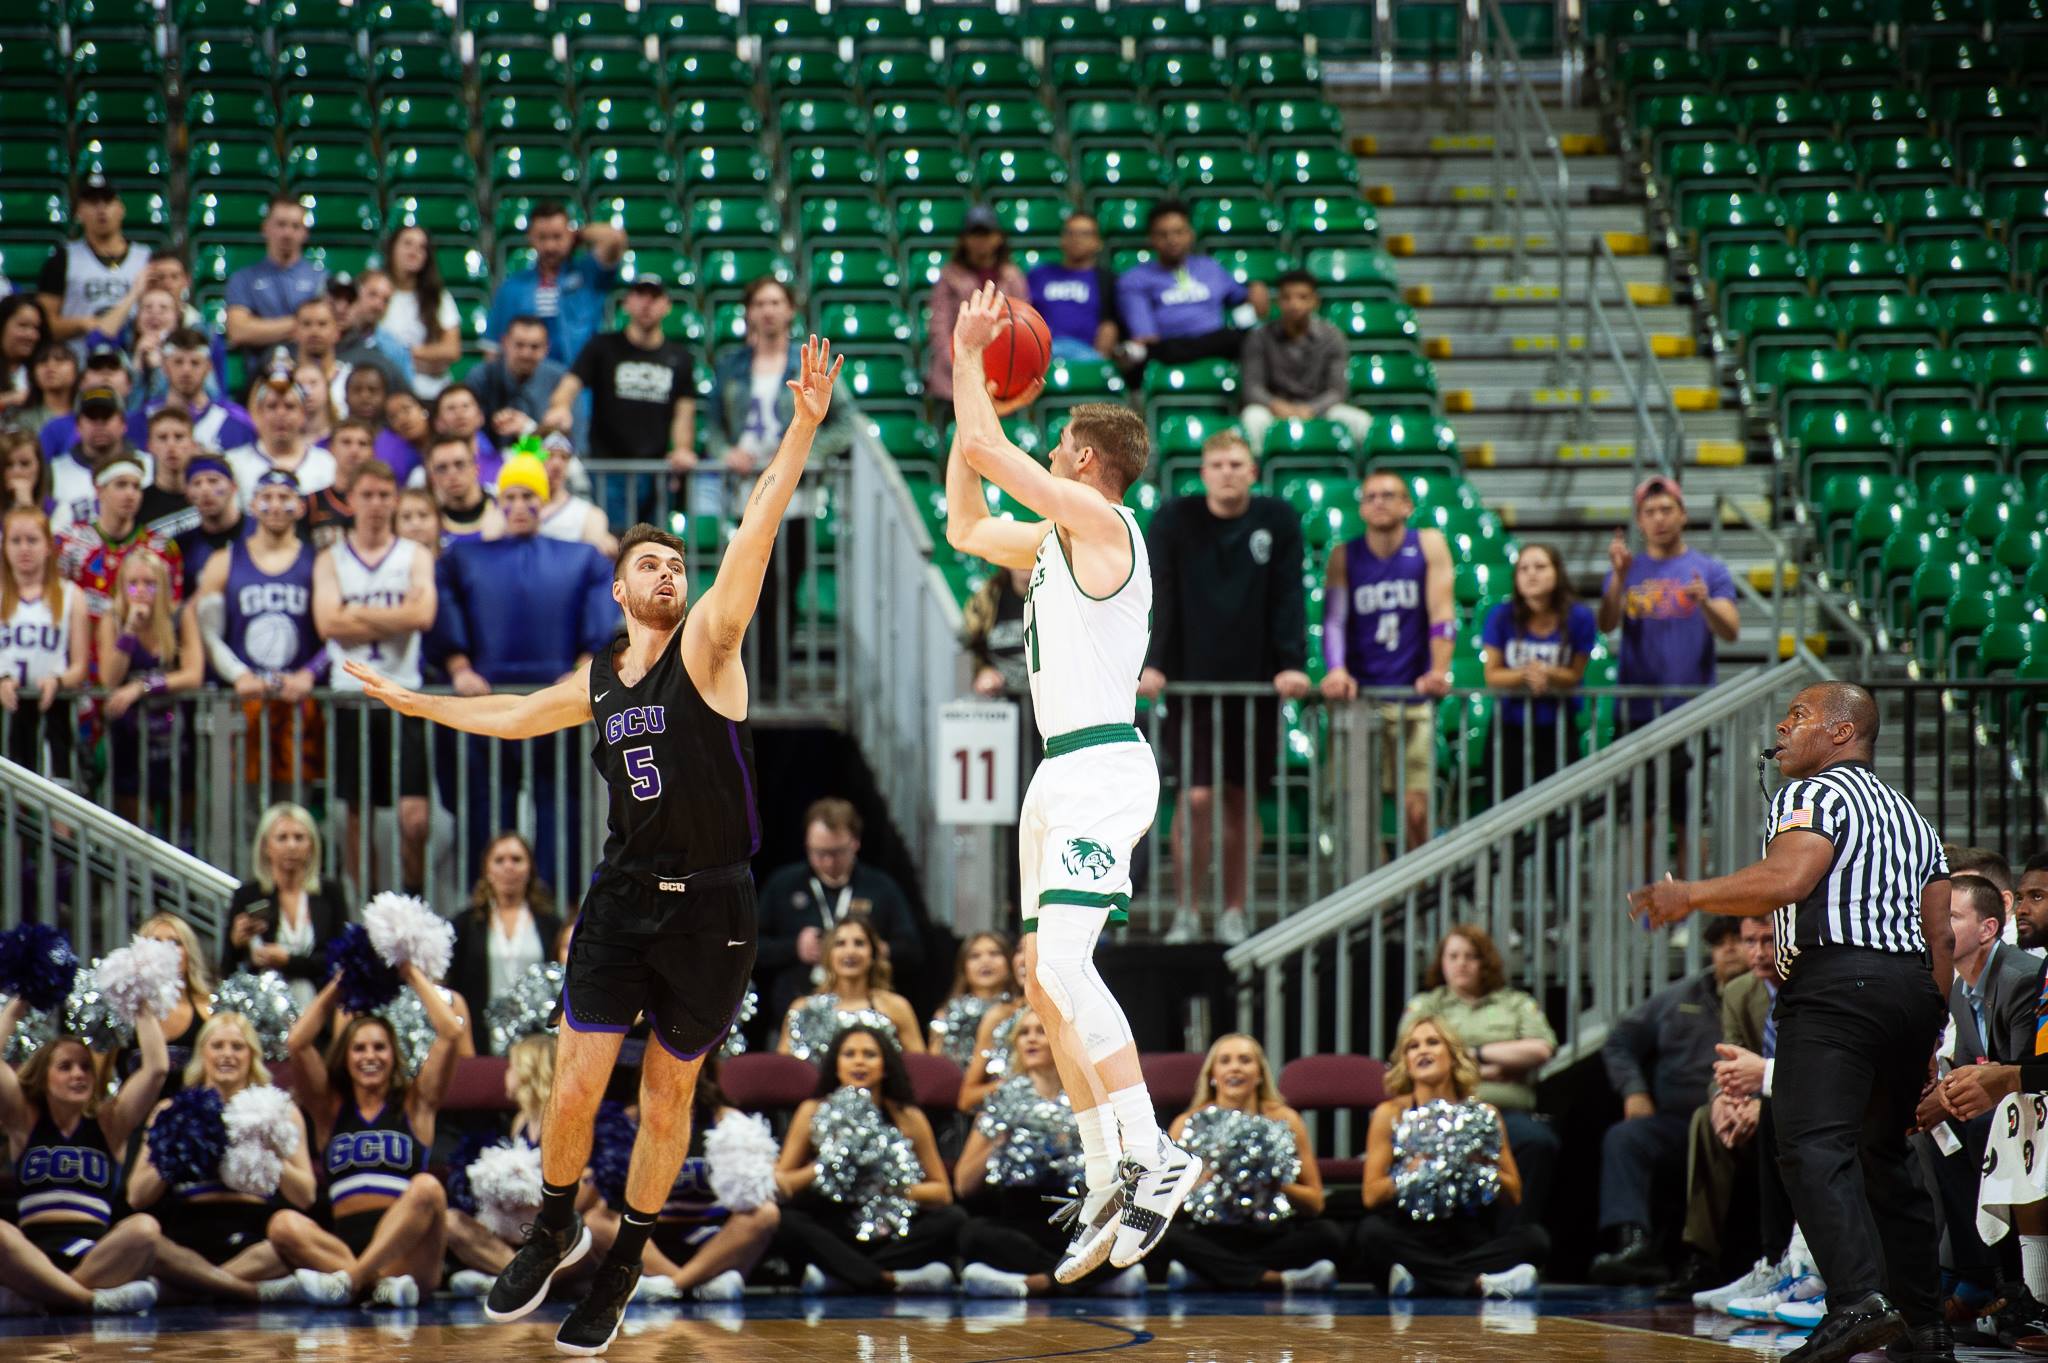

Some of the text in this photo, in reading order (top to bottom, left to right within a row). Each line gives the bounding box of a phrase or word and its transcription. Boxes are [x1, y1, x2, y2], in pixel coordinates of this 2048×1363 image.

[239, 583, 309, 616] GCU
[606, 705, 666, 745] GCU
[623, 745, 662, 801] 5
[953, 747, 995, 802] 11
[659, 881, 686, 893] GCU
[20, 1145, 110, 1188] GCU
[326, 1129, 413, 1174] GCU
